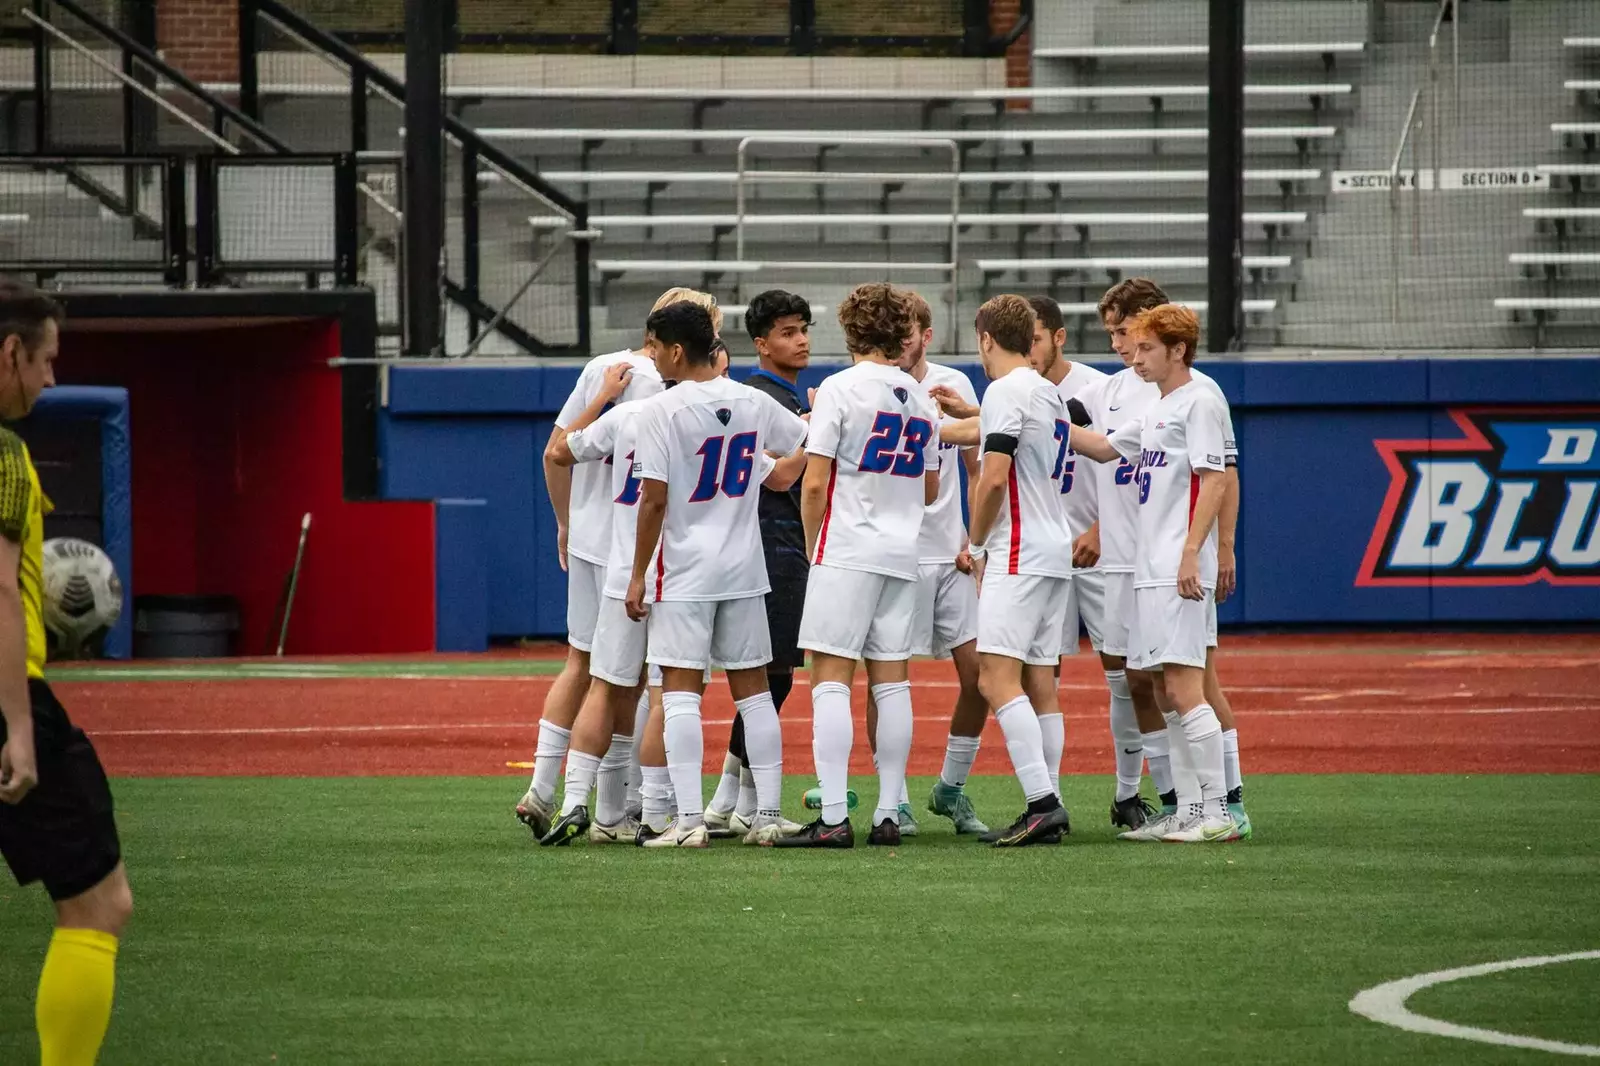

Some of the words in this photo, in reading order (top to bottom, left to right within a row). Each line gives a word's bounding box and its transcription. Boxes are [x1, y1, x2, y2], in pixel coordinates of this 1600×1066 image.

[1350, 175, 1405, 187] SECTIN
[1461, 171, 1517, 186] SECTION
[688, 431, 758, 503] 16
[857, 410, 933, 478] 23
[1050, 418, 1071, 480] 7
